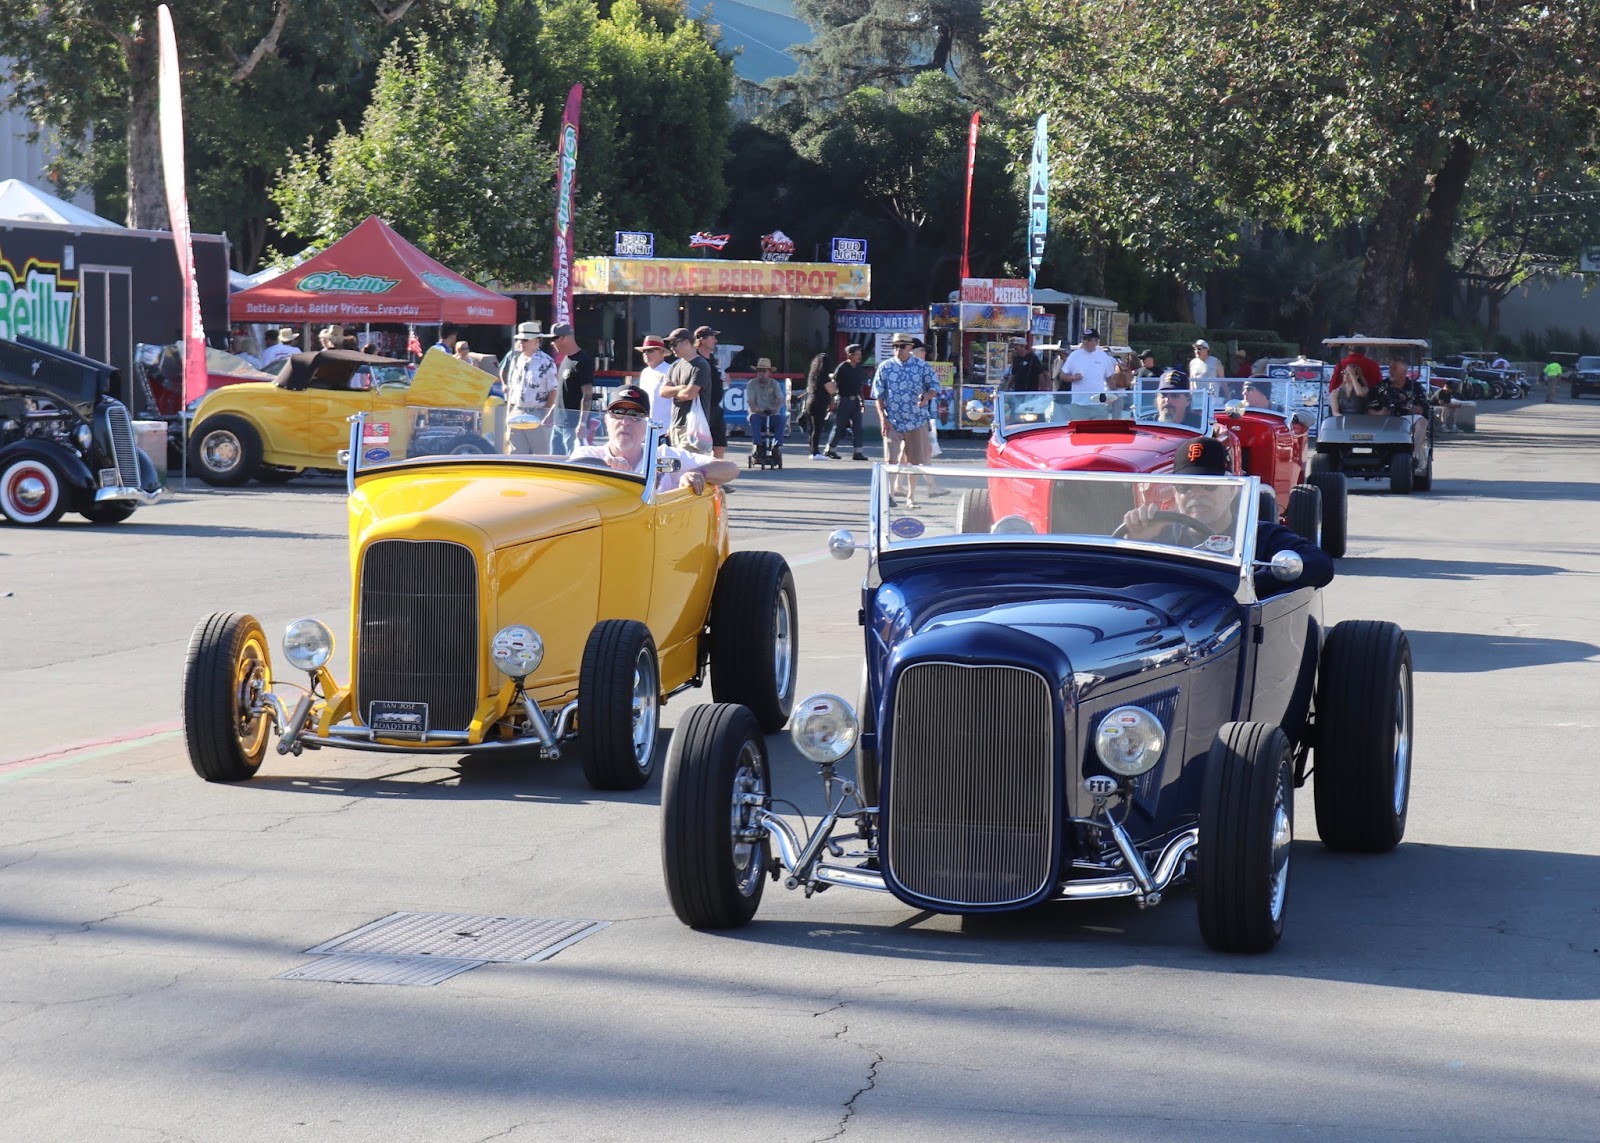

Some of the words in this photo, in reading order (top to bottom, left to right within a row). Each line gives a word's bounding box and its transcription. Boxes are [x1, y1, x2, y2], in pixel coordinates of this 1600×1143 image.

[622, 234, 648, 245] BUD
[617, 244, 651, 254] LIGHT
[838, 240, 861, 251] BUD
[761, 253, 793, 261] LIGHT
[834, 250, 865, 260] LIGHT
[643, 265, 713, 291] DRAFT
[718, 268, 764, 292] BEER
[771, 269, 838, 294] DEPOT
[994, 287, 1027, 302] PRETZELS
[247, 303, 276, 313] Better
[309, 303, 338, 313] Better
[846, 316, 857, 328] ICE
[860, 316, 881, 328] COLD
[883, 316, 913, 328] WATER
[373, 722, 423, 731] ROADSTERS
[1089, 780, 1111, 792] FTF
